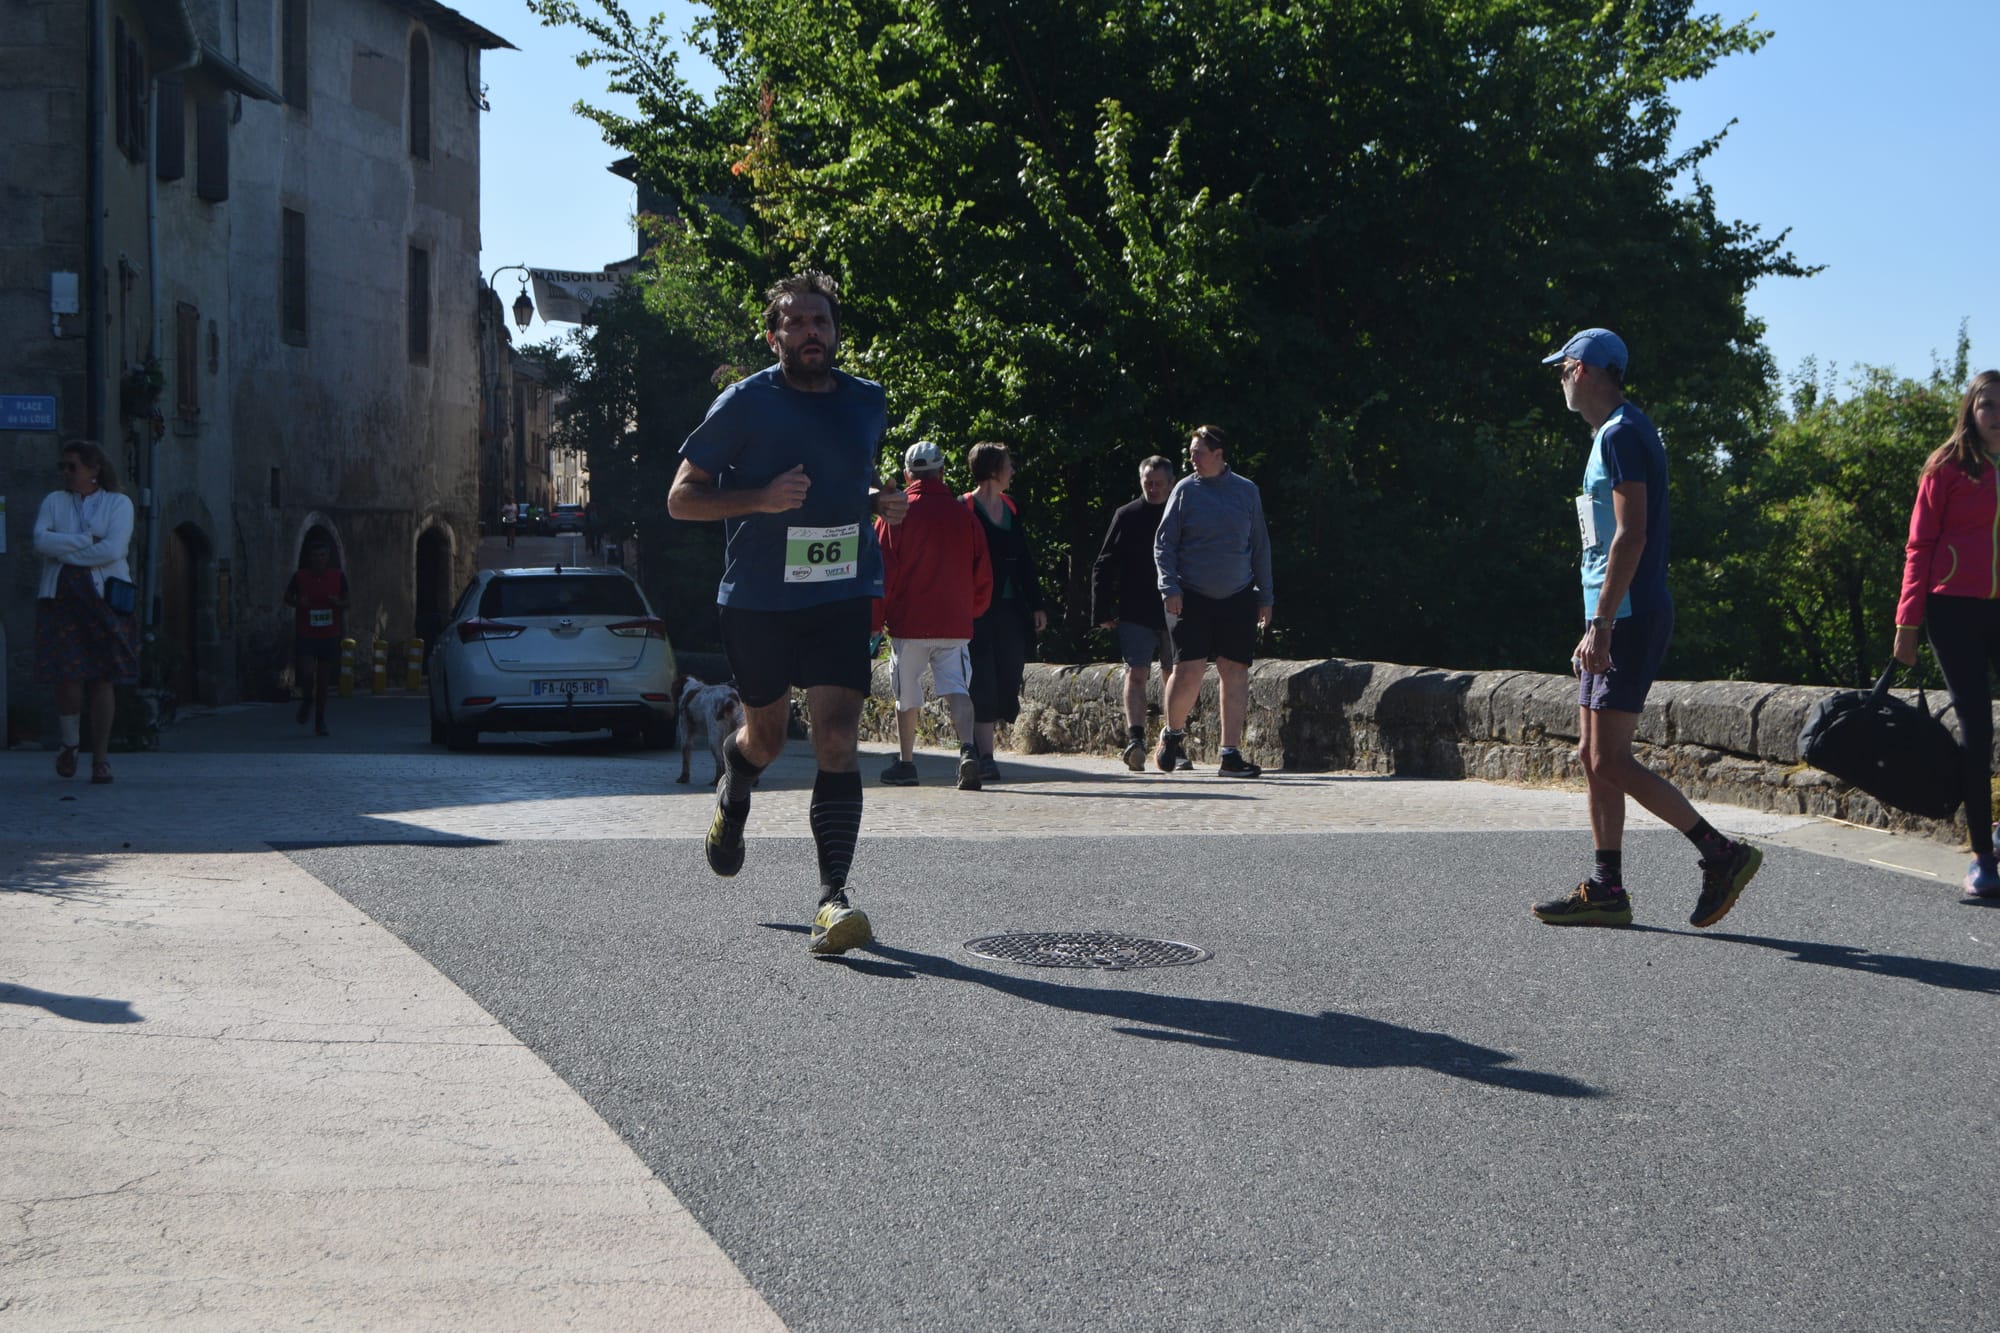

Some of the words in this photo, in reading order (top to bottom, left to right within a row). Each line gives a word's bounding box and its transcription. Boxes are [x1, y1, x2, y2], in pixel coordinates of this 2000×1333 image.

[535, 271, 591, 282] MAISON
[597, 273, 614, 282] DE
[17, 401, 42, 410] PLACE
[807, 541, 841, 564] 66
